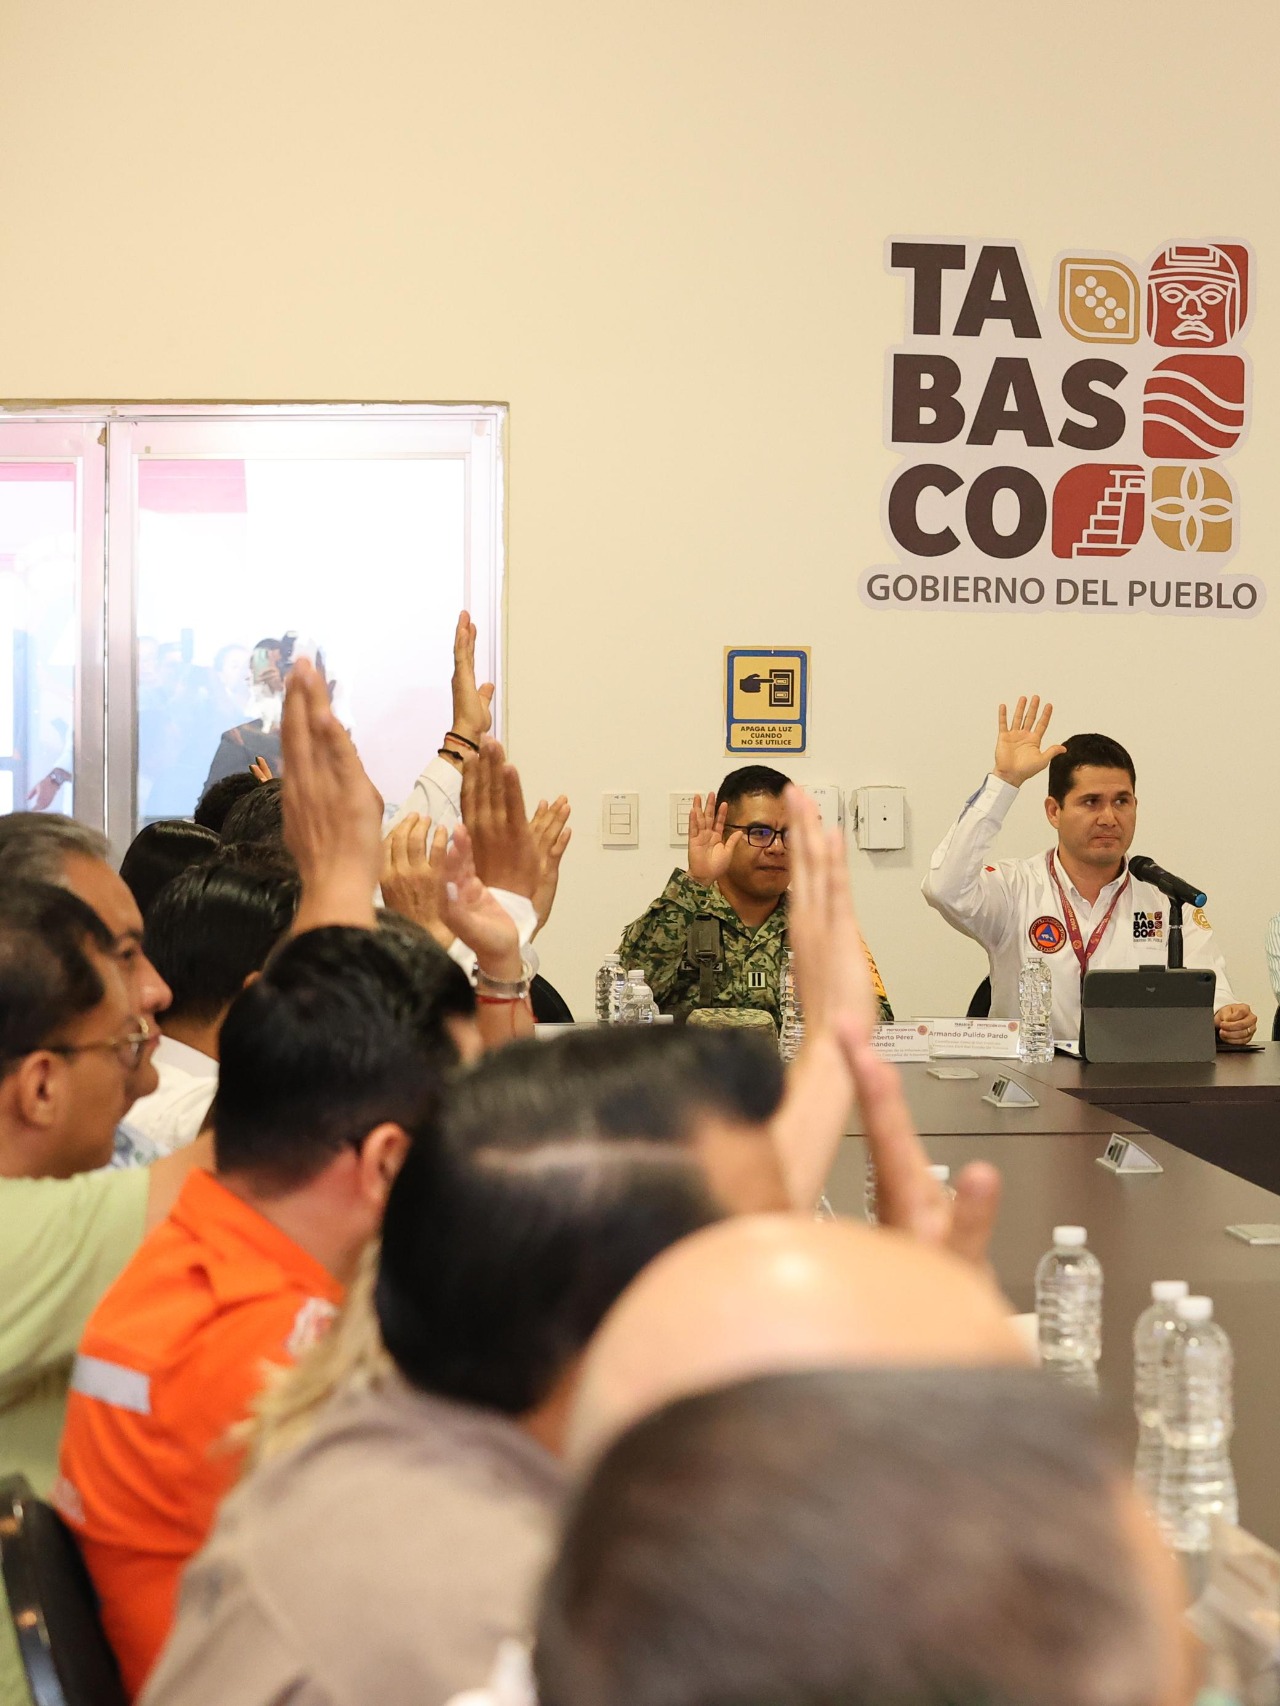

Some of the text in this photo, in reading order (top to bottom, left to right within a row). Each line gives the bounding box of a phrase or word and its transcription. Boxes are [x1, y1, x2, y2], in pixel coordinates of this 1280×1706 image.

[890, 242, 1043, 339] TA
[891, 353, 1129, 451] BAS
[888, 463, 1047, 560] CO
[866, 573, 1258, 610] GOBIERNO DEL PUEBLO
[1133, 911, 1147, 921] TA
[928, 1030, 961, 1038] Armando
